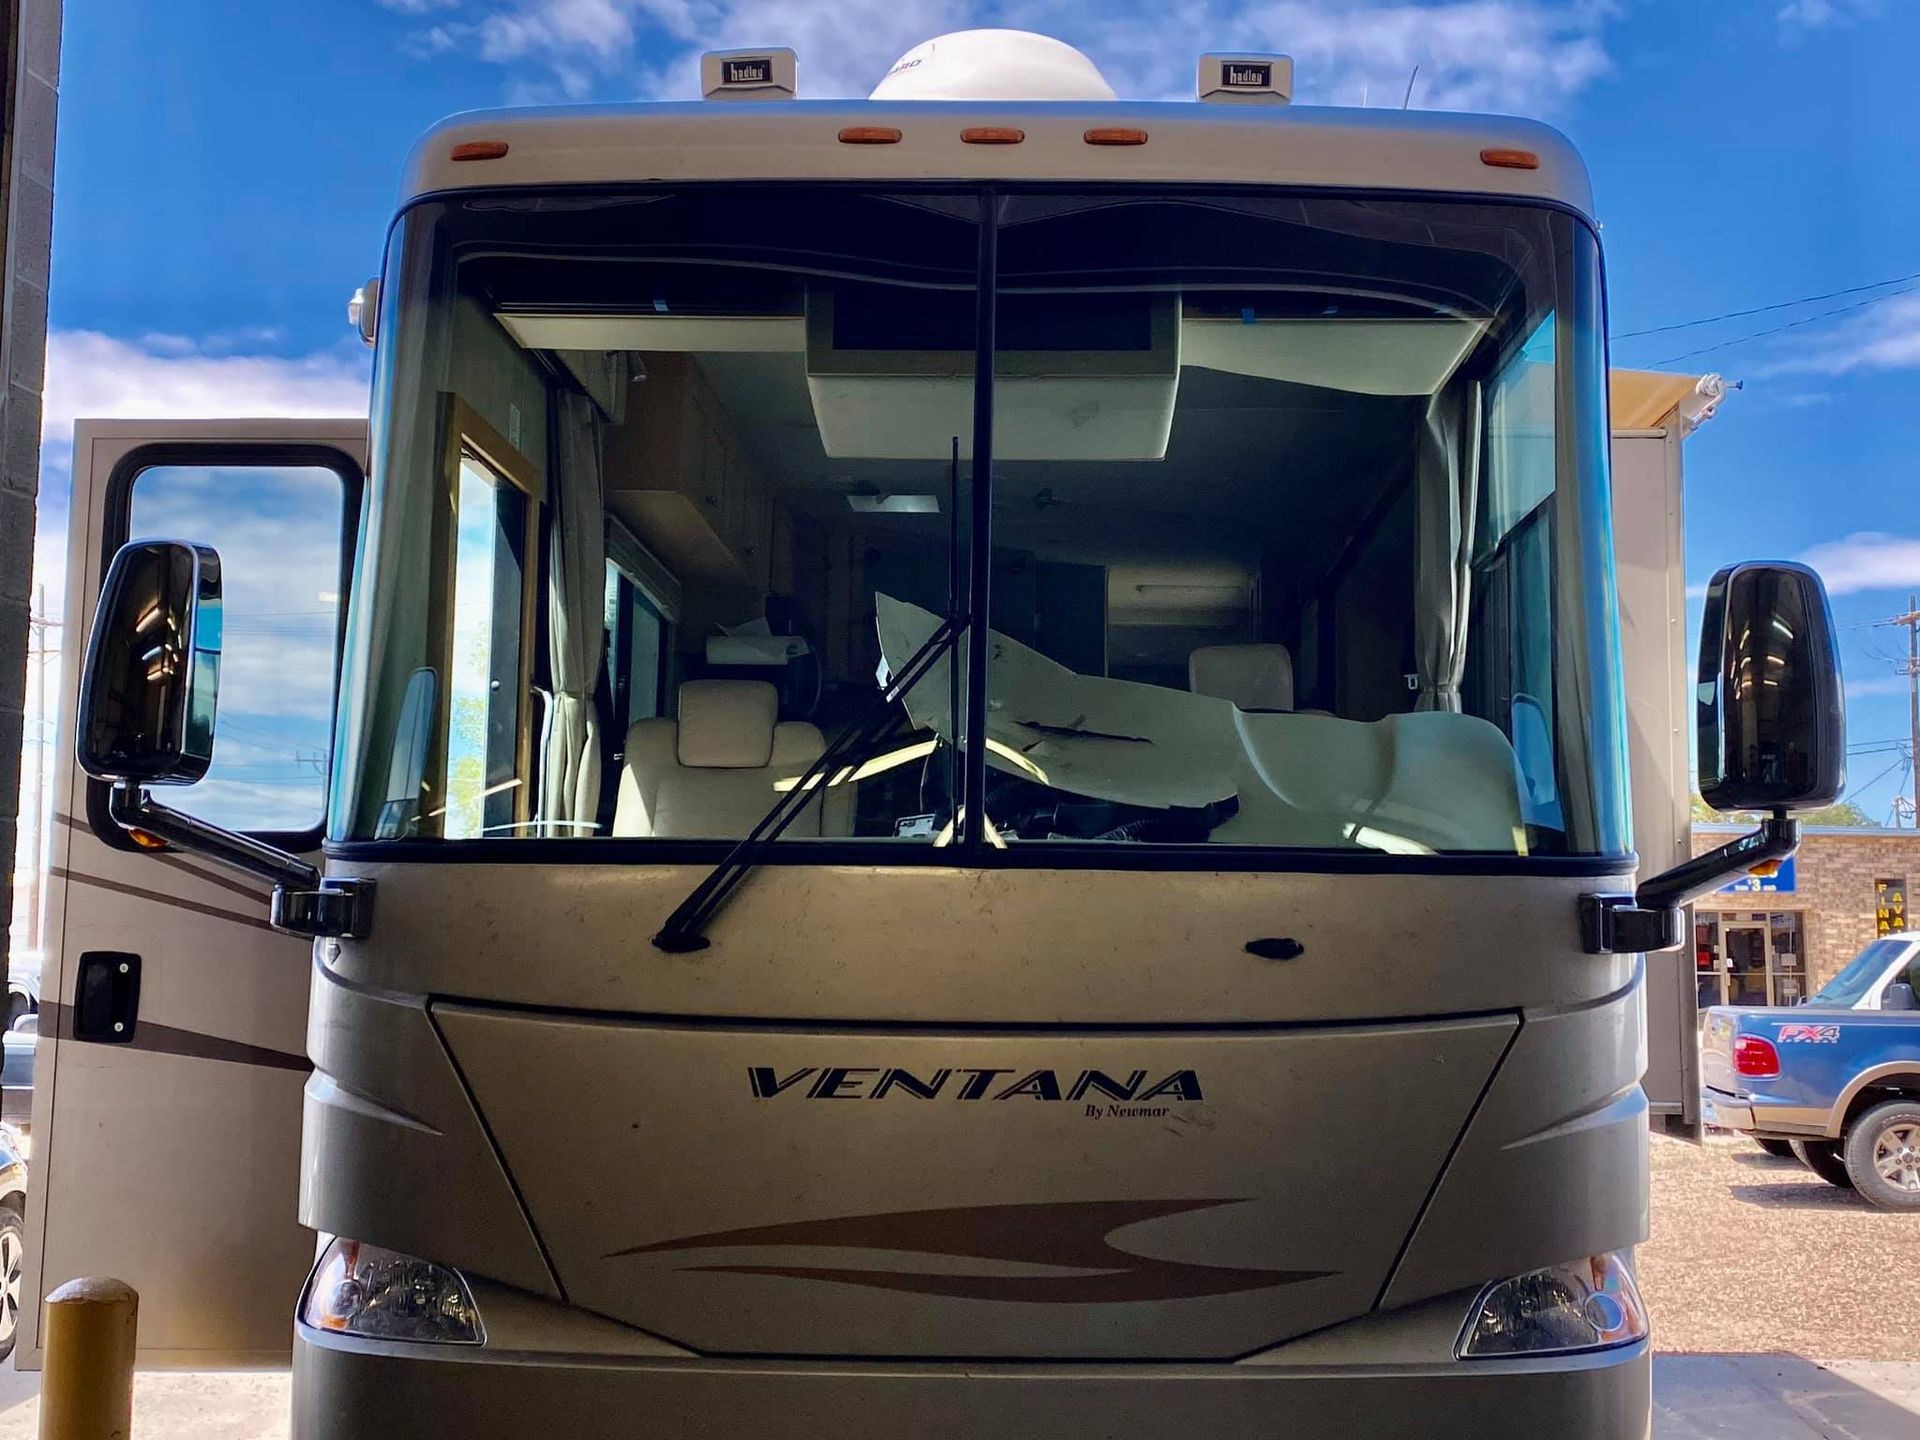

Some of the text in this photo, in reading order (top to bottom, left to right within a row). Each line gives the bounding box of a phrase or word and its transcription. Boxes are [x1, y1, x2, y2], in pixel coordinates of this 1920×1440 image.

[730, 62, 763, 82] hadley
[1230, 65, 1263, 84] hadley
[1878, 884, 1890, 937] FINA
[1779, 1026, 1840, 1040] FX4
[748, 1067, 1203, 1101] VENTANA
[1085, 1104, 1170, 1119] By Newmar
